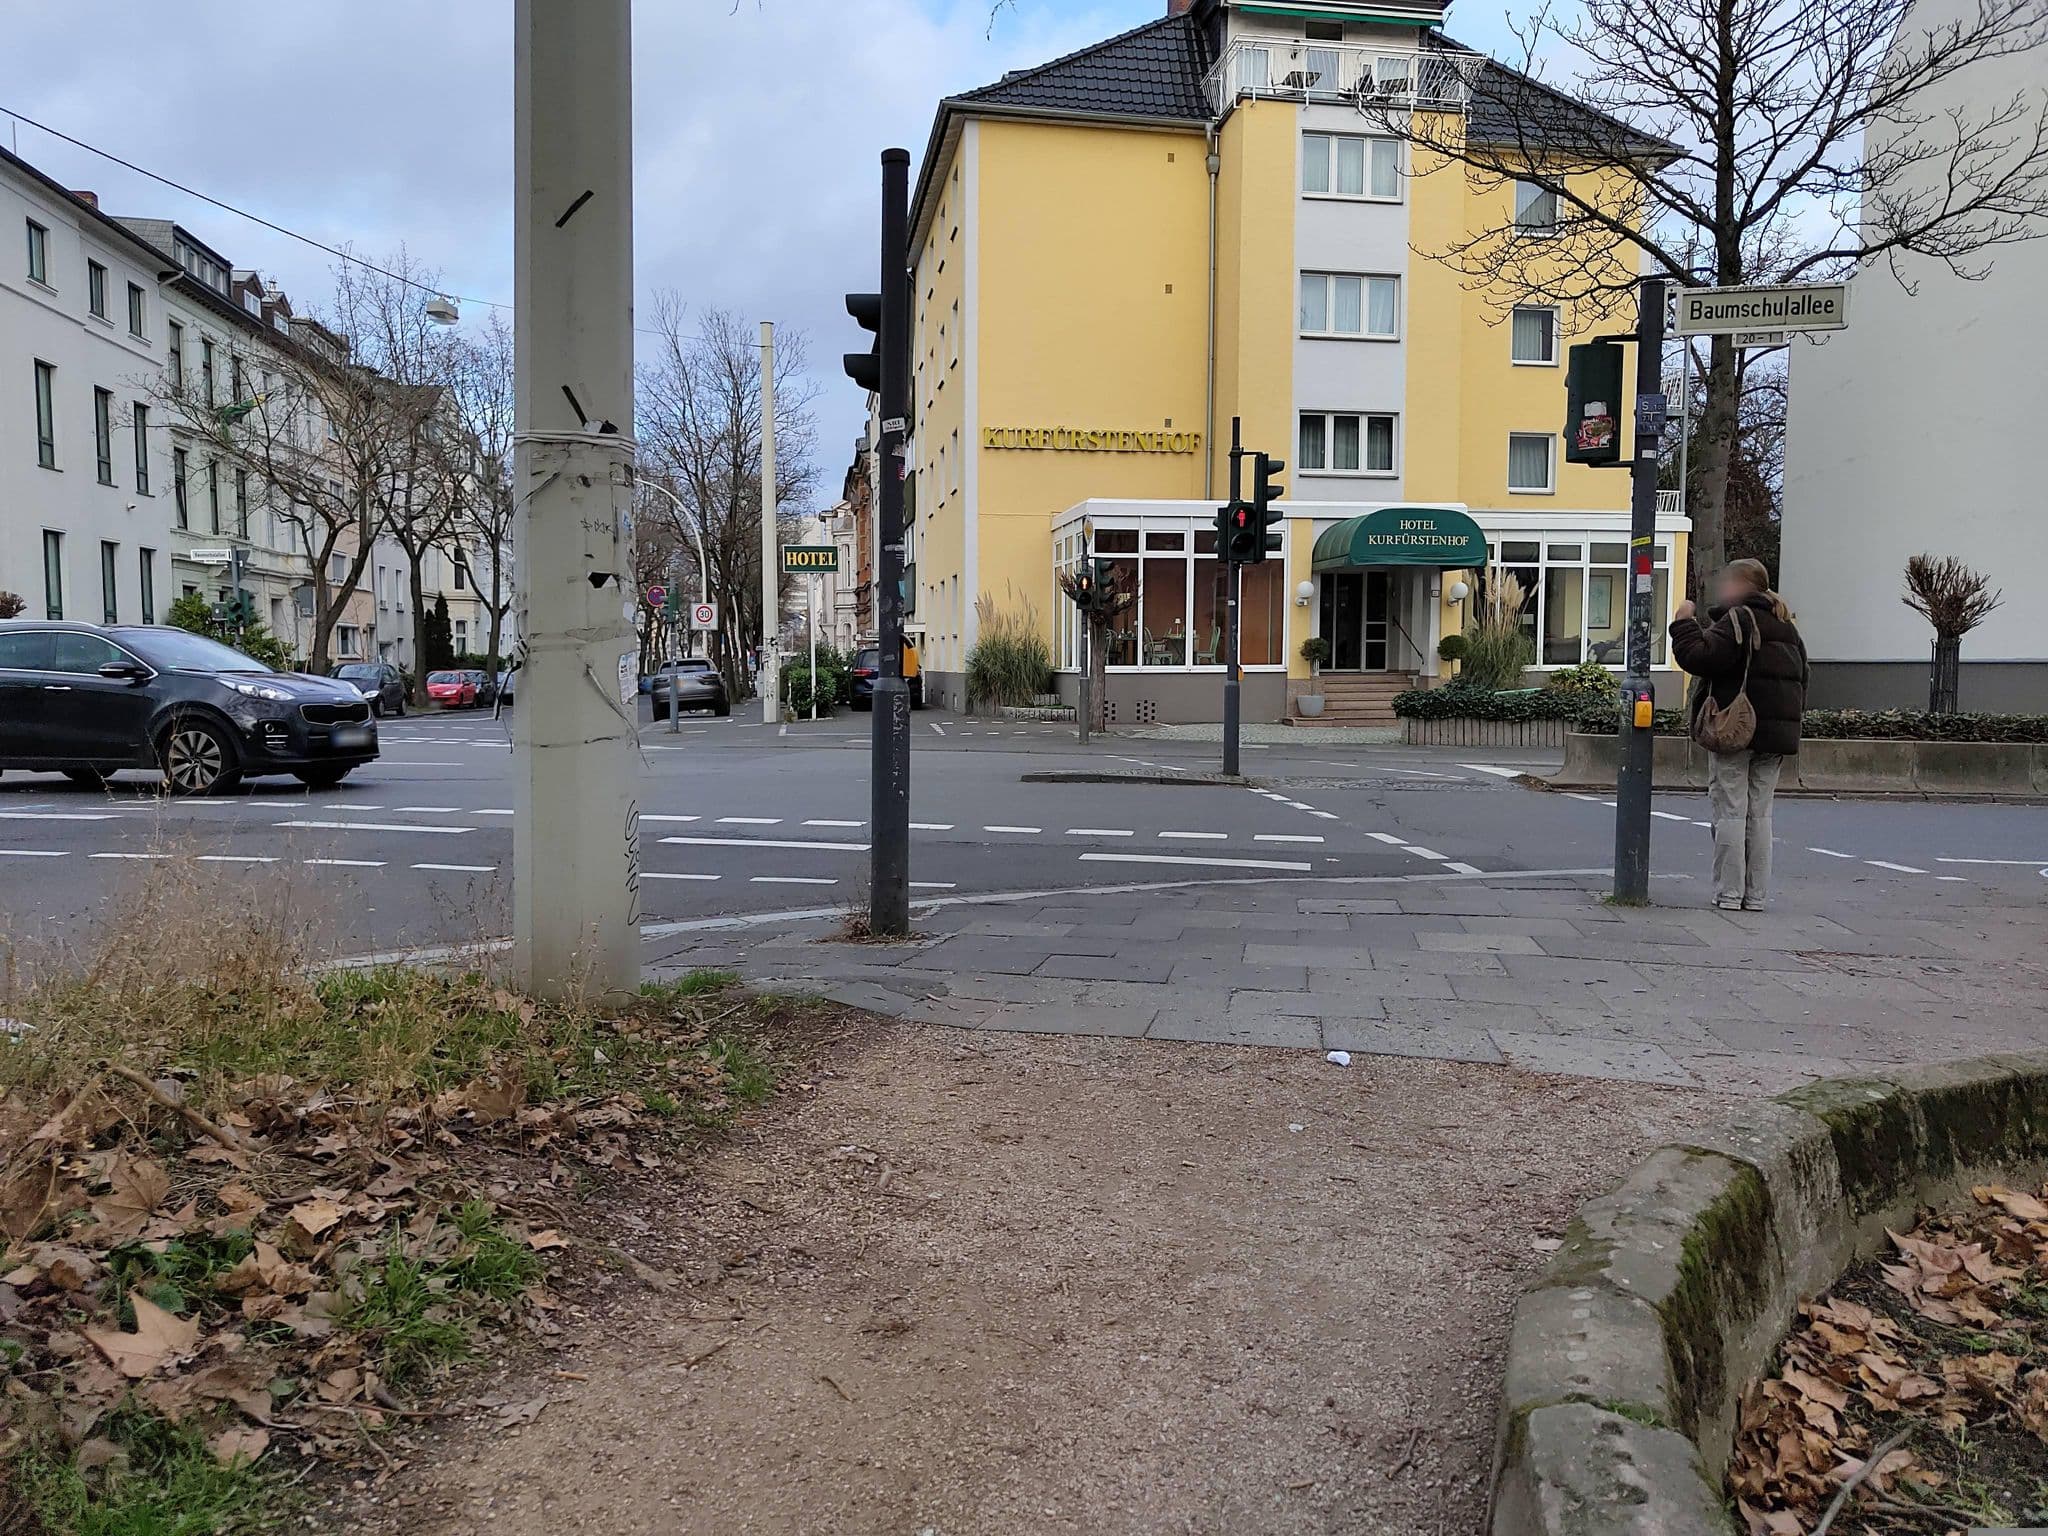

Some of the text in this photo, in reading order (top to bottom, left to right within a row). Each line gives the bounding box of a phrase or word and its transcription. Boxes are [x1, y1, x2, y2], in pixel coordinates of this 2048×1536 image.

[1690, 294, 1834, 320] Baumschulallee
[1742, 334, 1755, 344] 20
[984, 425, 1202, 453] KURFÜRSTENHOF
[1400, 519, 1437, 530] HOTEL
[1368, 533, 1469, 546] KURFÜRSTENHOF
[786, 551, 837, 566] HOTEL
[699, 610, 710, 619] 30
